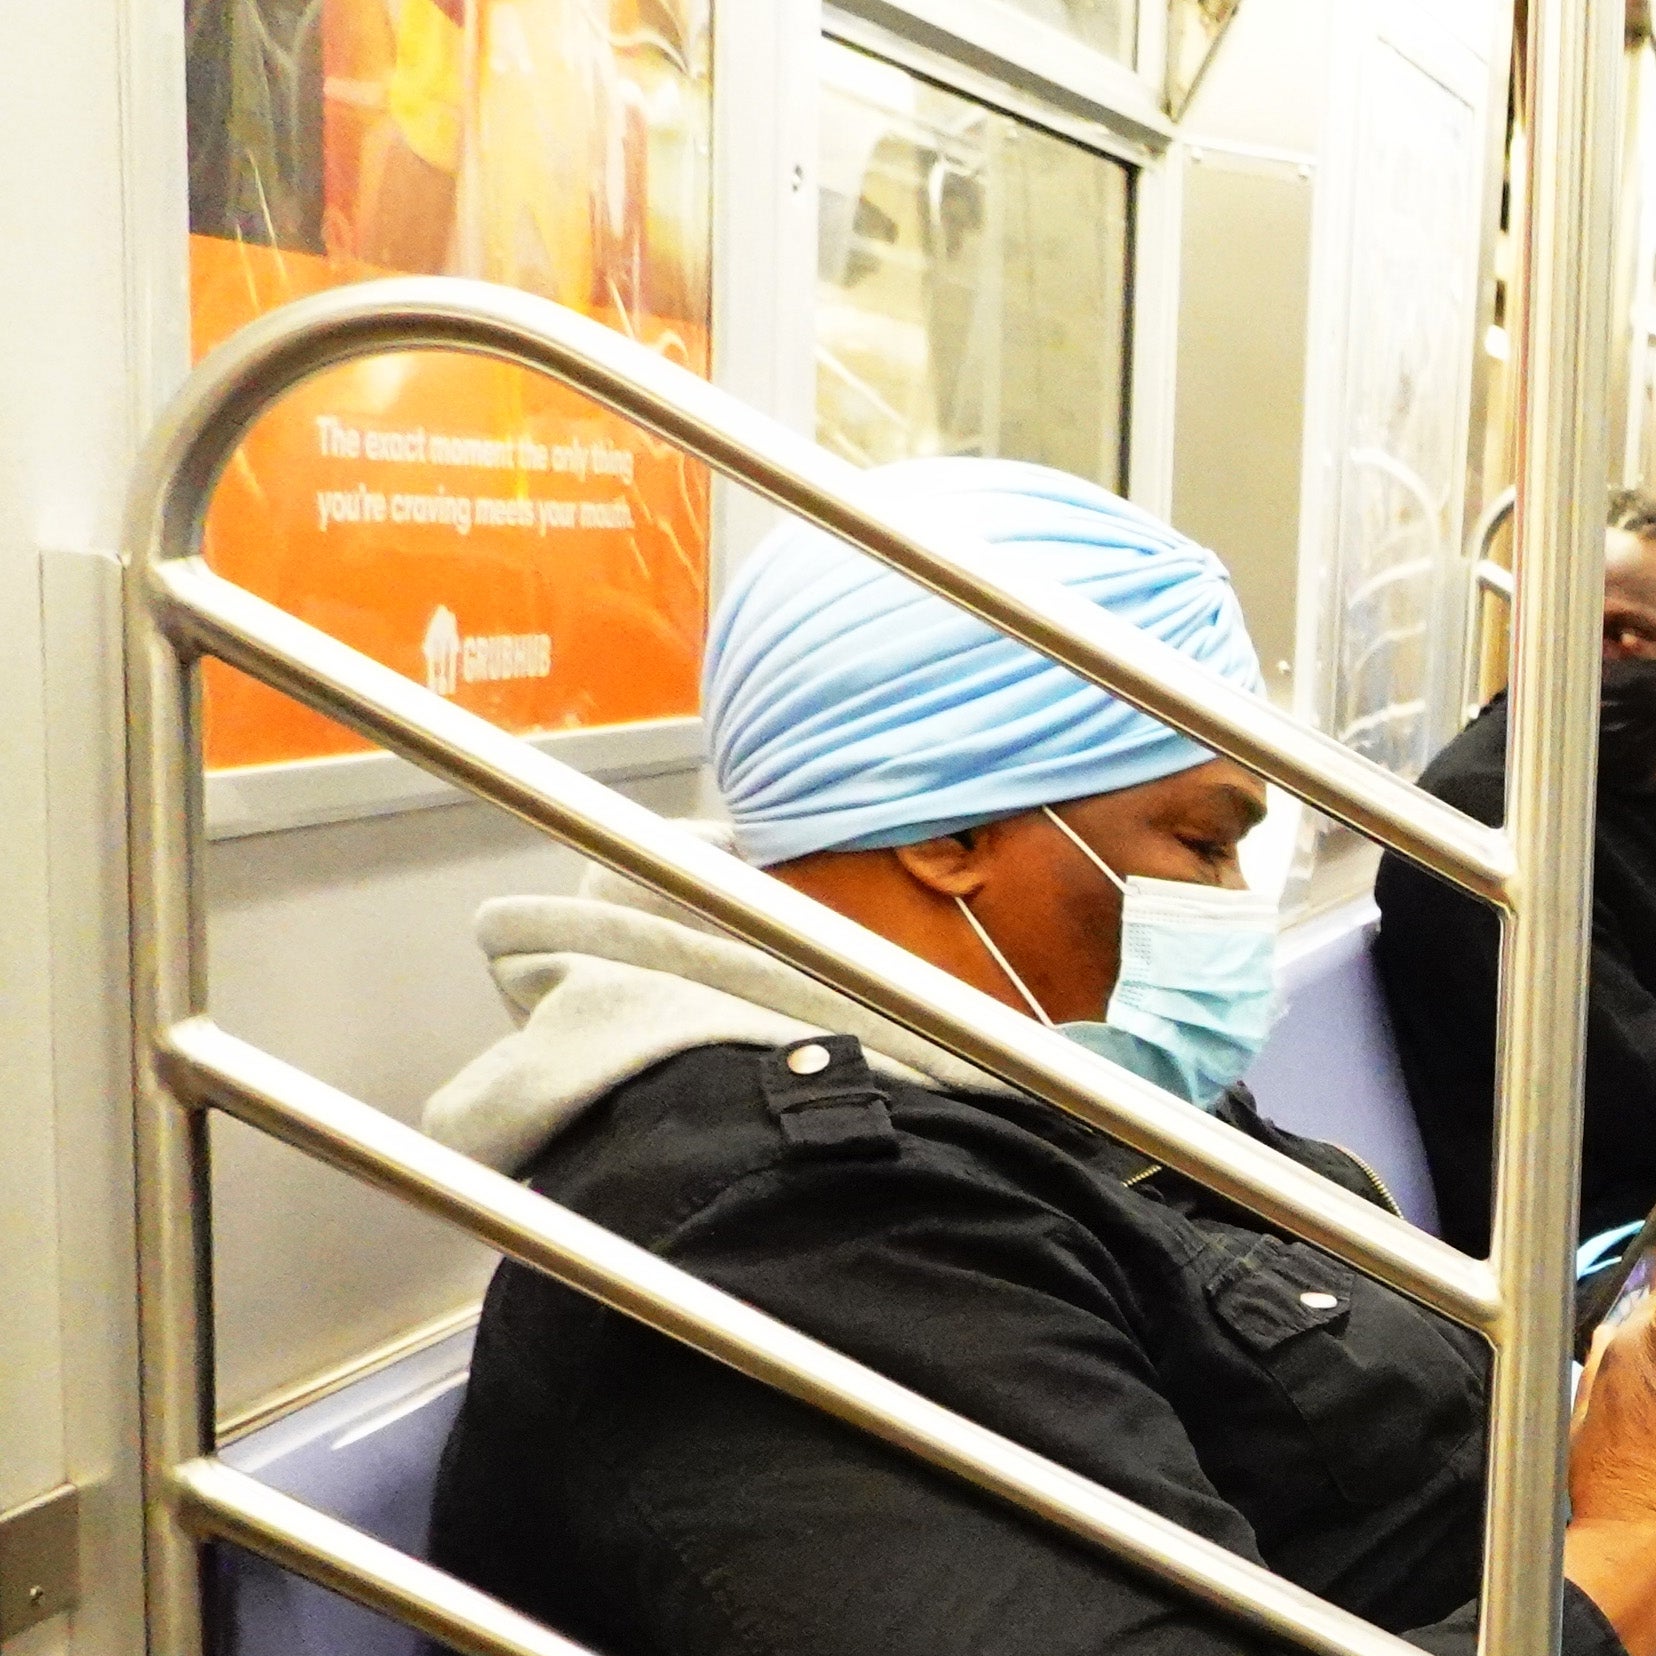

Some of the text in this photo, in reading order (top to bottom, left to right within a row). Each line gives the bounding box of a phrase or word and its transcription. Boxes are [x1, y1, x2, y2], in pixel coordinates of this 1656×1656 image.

[316, 416, 635, 486] The exact moment the only thing
[316, 482, 387, 533] you're
[391, 484, 473, 536] craving
[475, 498, 534, 528] meets
[539, 499, 576, 538] your
[462, 633, 552, 684] GRUBHUB
